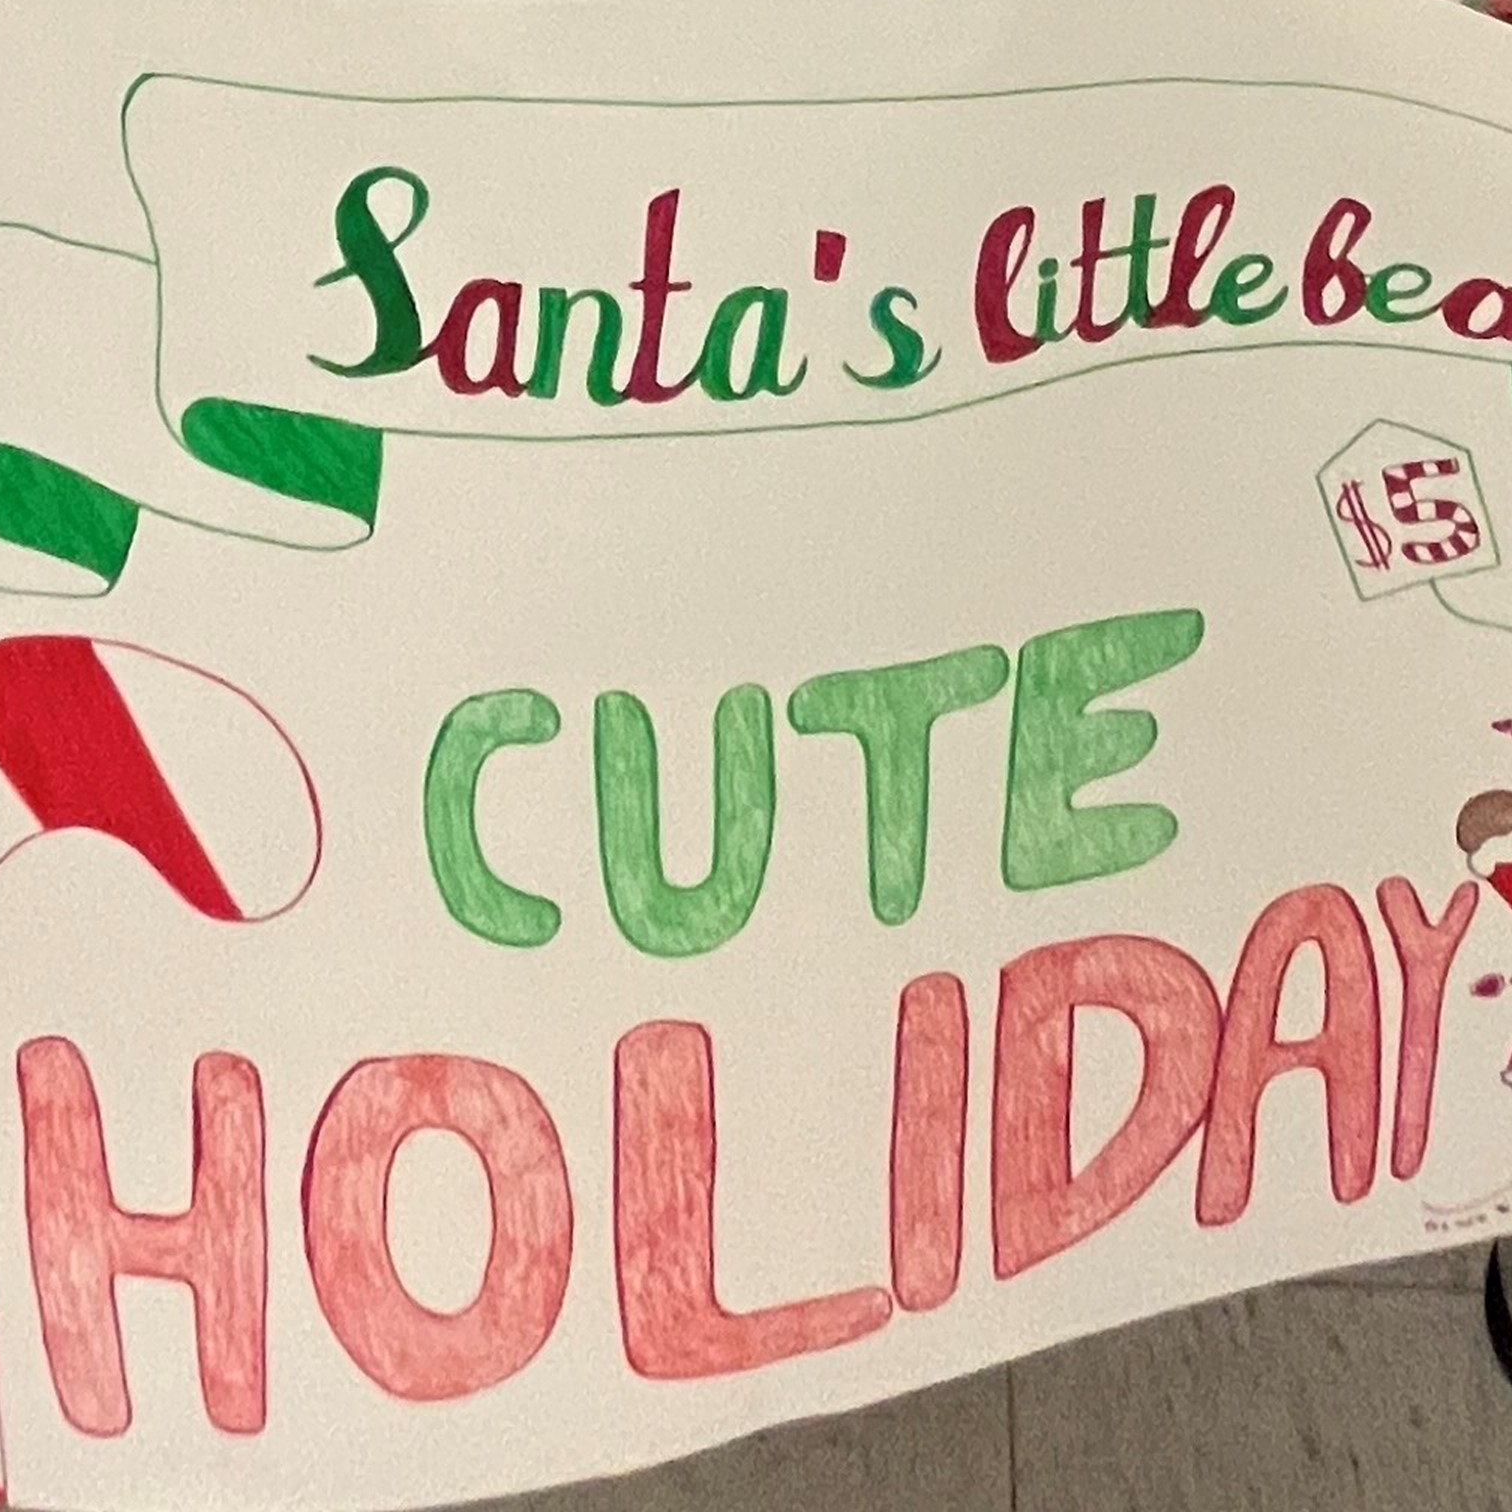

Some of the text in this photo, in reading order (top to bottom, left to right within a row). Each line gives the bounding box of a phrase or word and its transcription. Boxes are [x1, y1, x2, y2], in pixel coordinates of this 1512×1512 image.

[305, 164, 944, 408] Santa's
[1335, 456, 1482, 571] $5
[422, 606, 1206, 958] CUTE
[16, 875, 1480, 1436] HOLIDAY
